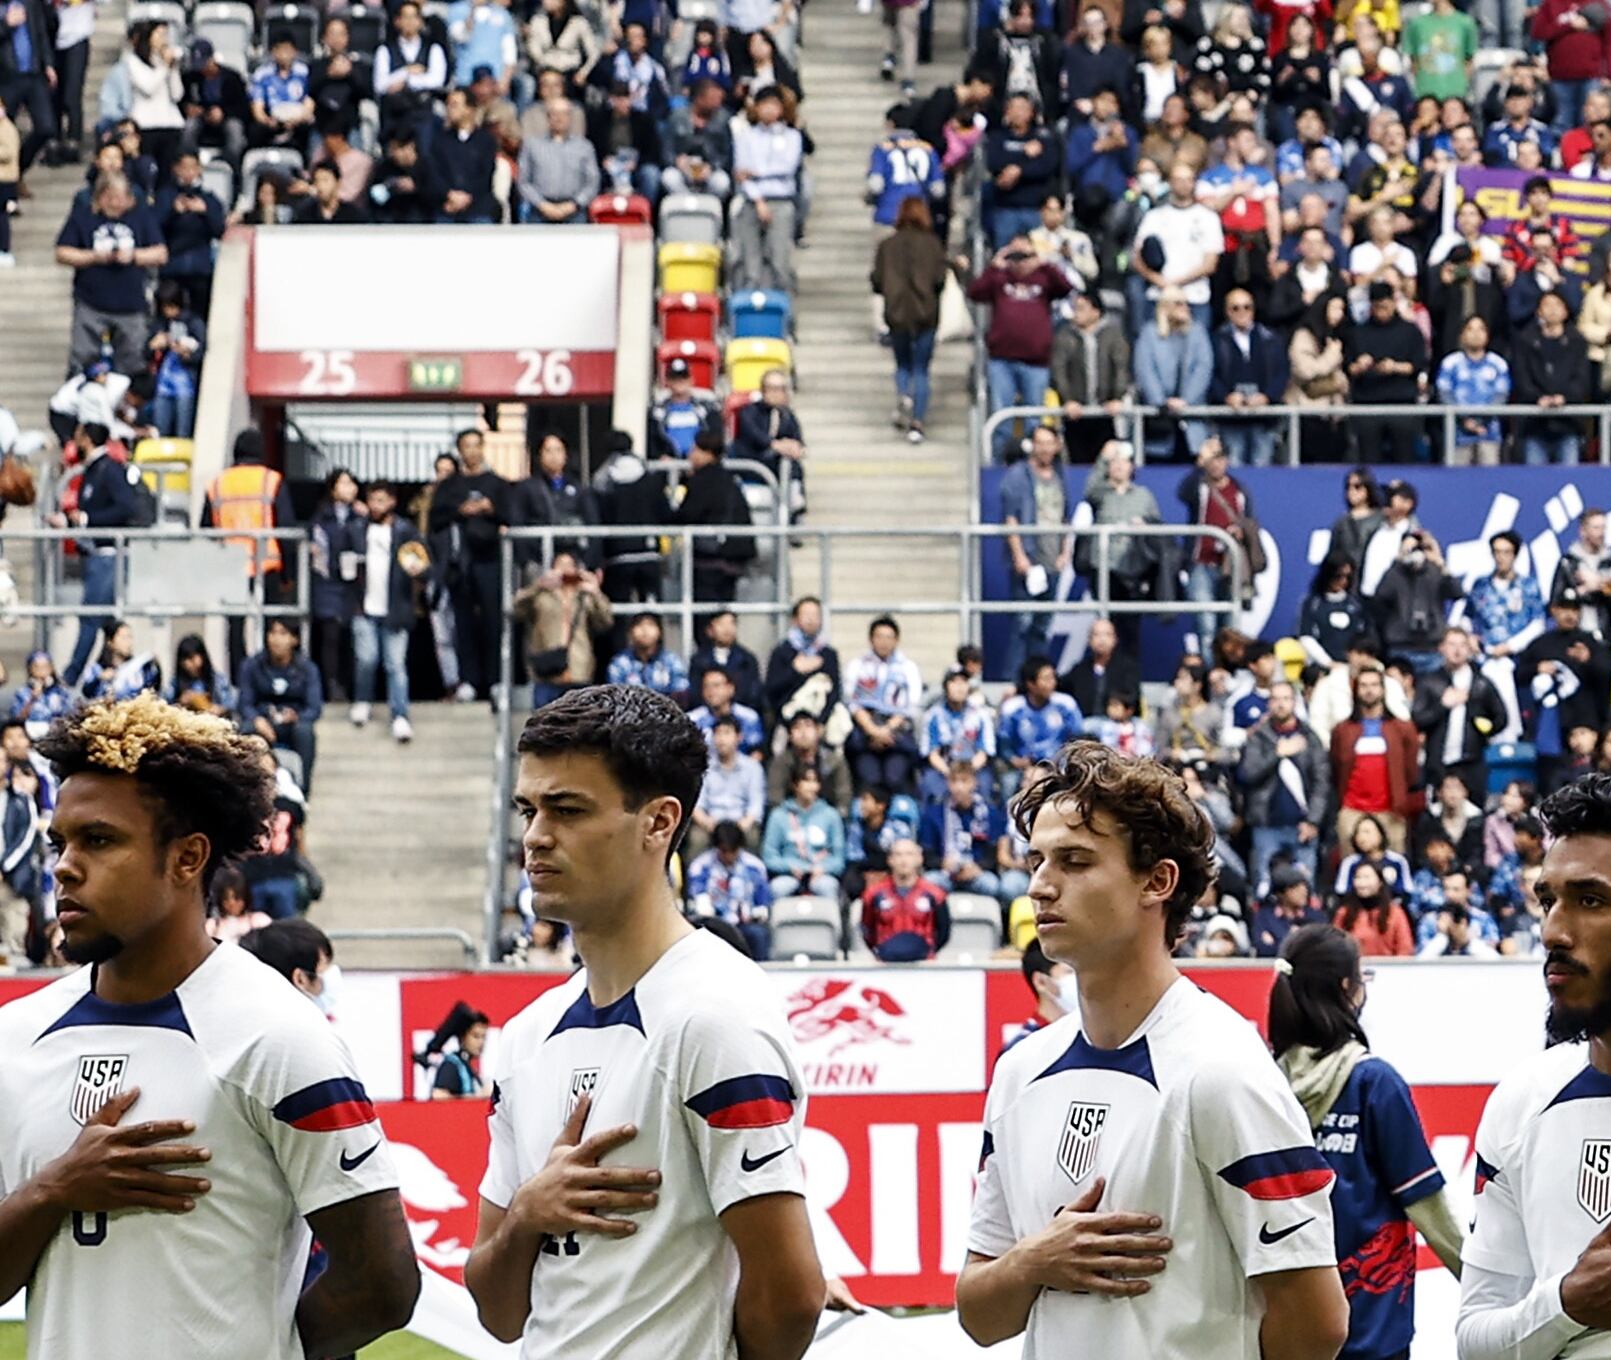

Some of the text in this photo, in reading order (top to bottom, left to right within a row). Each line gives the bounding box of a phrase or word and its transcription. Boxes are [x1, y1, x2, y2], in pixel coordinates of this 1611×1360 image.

[301, 351, 356, 395] 25
[514, 350, 571, 395] 26
[81, 1060, 124, 1087] USA
[572, 1072, 597, 1097] USA
[1070, 1106, 1107, 1136] USA
